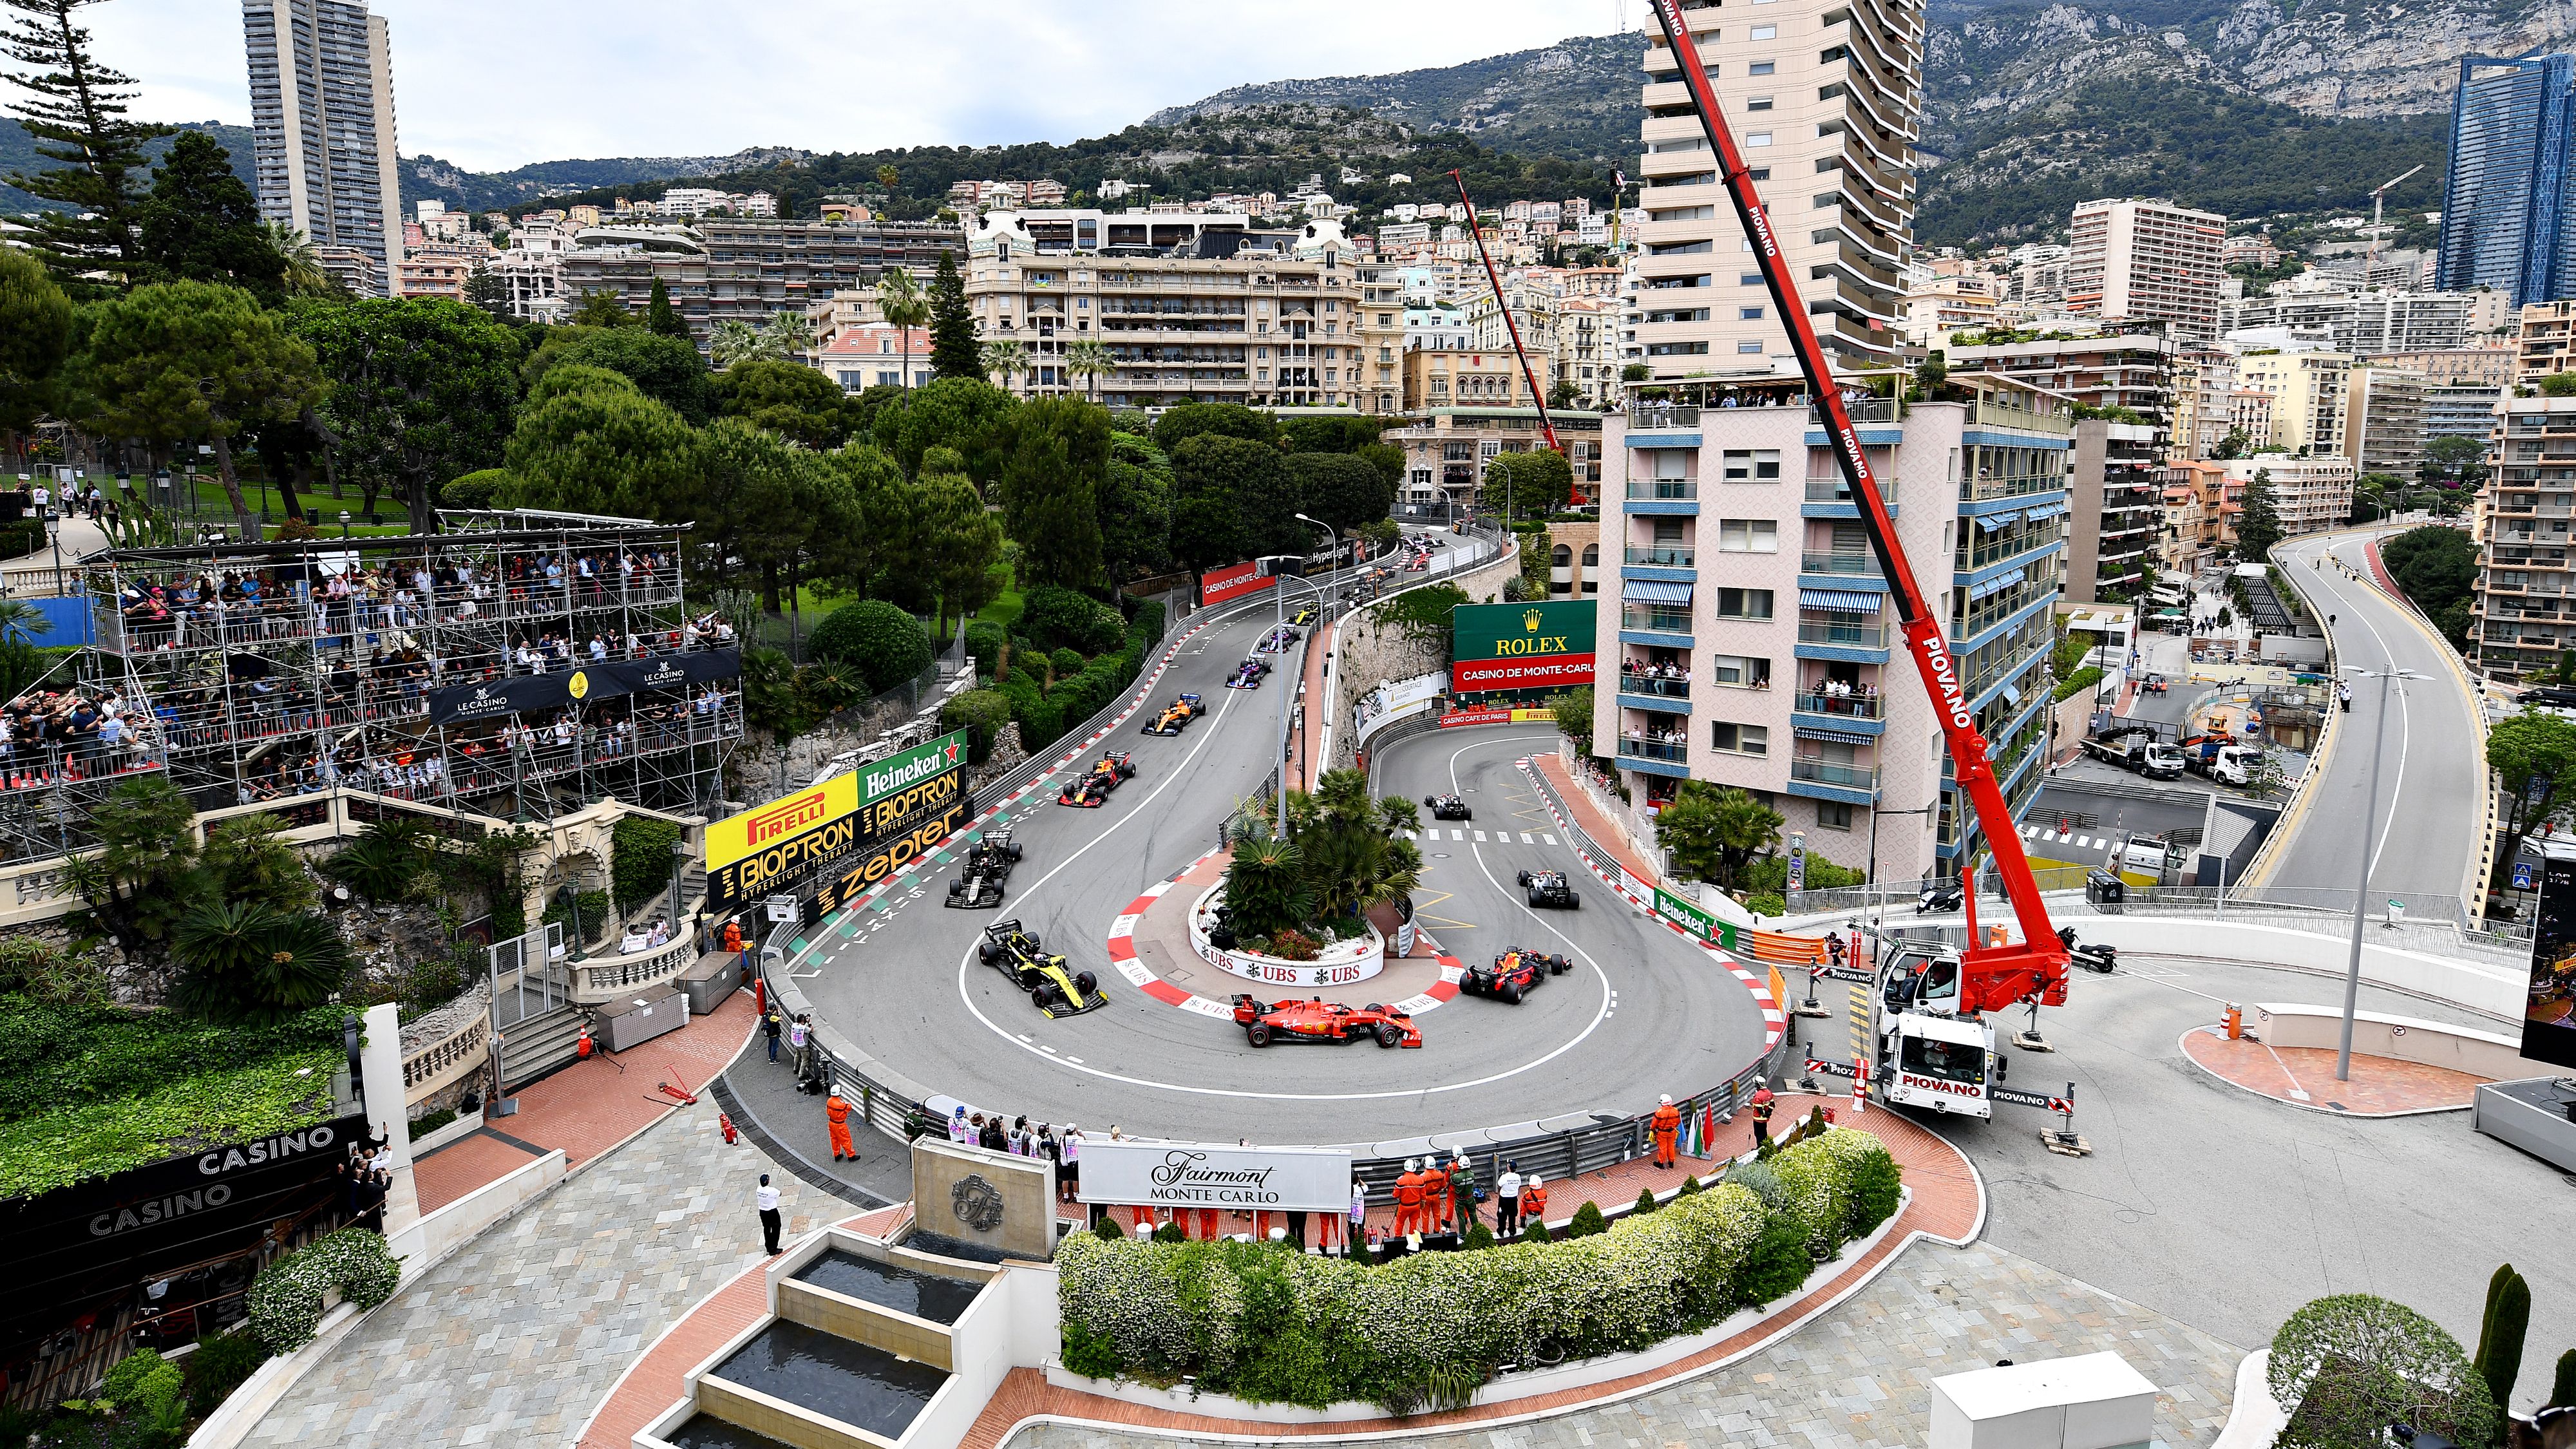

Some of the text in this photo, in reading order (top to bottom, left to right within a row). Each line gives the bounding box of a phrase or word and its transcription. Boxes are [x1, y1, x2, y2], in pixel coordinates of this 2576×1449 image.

[1748, 205, 1776, 258] PIOVANO
[1840, 428, 1868, 480] PIOVANO
[1206, 581, 1226, 594] CASINO
[1226, 579, 1233, 587] DE
[1496, 636, 1567, 656] ROLEX
[644, 670, 684, 682] LE CASINO
[647, 677, 682, 685] MONTE-CARLO
[1463, 669, 1504, 680] CASINO
[1507, 668, 1522, 677] DE
[1922, 636, 1971, 728] PIOVANO
[457, 697, 507, 711] LE CASINO
[461, 705, 505, 715] MONTE-CARLO
[866, 752, 940, 799] Heineken
[876, 770, 957, 826] BIOPTRON
[748, 792, 824, 846] PIRELLI
[876, 792, 957, 837] HYPERLIGHT THERAPY
[741, 818, 853, 888] BIOPTRON
[741, 844, 853, 901] HYPERLIGHT THERAPY
[1659, 894, 1705, 936] Heineken
[1210, 952, 1233, 970] UBS
[1263, 967, 1297, 983] UBS
[1331, 965, 1360, 983] UBS
[1203, 1004, 1232, 1016] UBS
[1410, 997, 1435, 1008] UBS
[1902, 1075, 1981, 1097] PIOVANO
[1994, 1091, 2045, 1106] PIOVANO
[198, 1127, 334, 1175] CASINO
[1151, 1150, 1278, 1189] Fairmont
[1151, 1188, 1280, 1204] MONTE CARLO
[90, 1184, 231, 1236] CASINO
